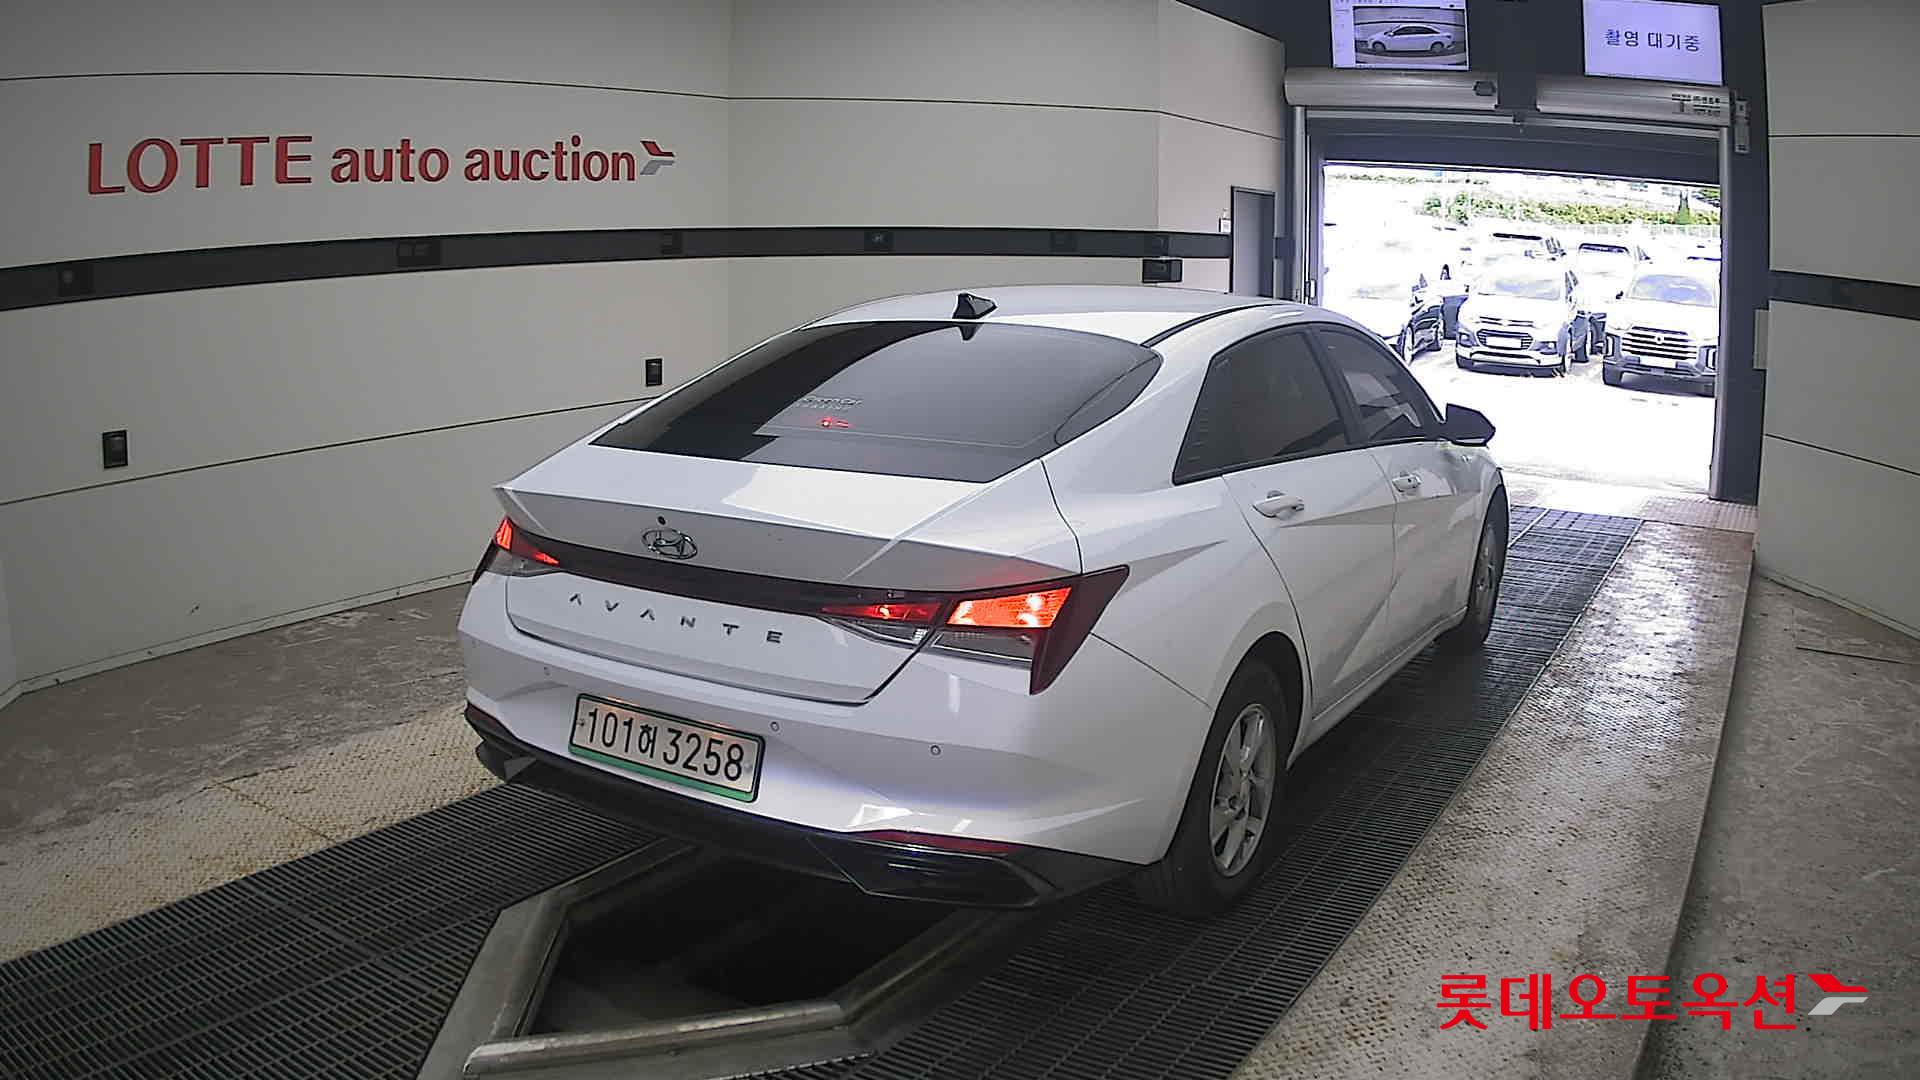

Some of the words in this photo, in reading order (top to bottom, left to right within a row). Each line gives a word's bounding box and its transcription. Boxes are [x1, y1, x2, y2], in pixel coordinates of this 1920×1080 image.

[88, 135, 313, 195] LOTTE
[330, 138, 450, 183] auto
[463, 135, 637, 183] auction
[568, 592, 783, 645] AVANTE
